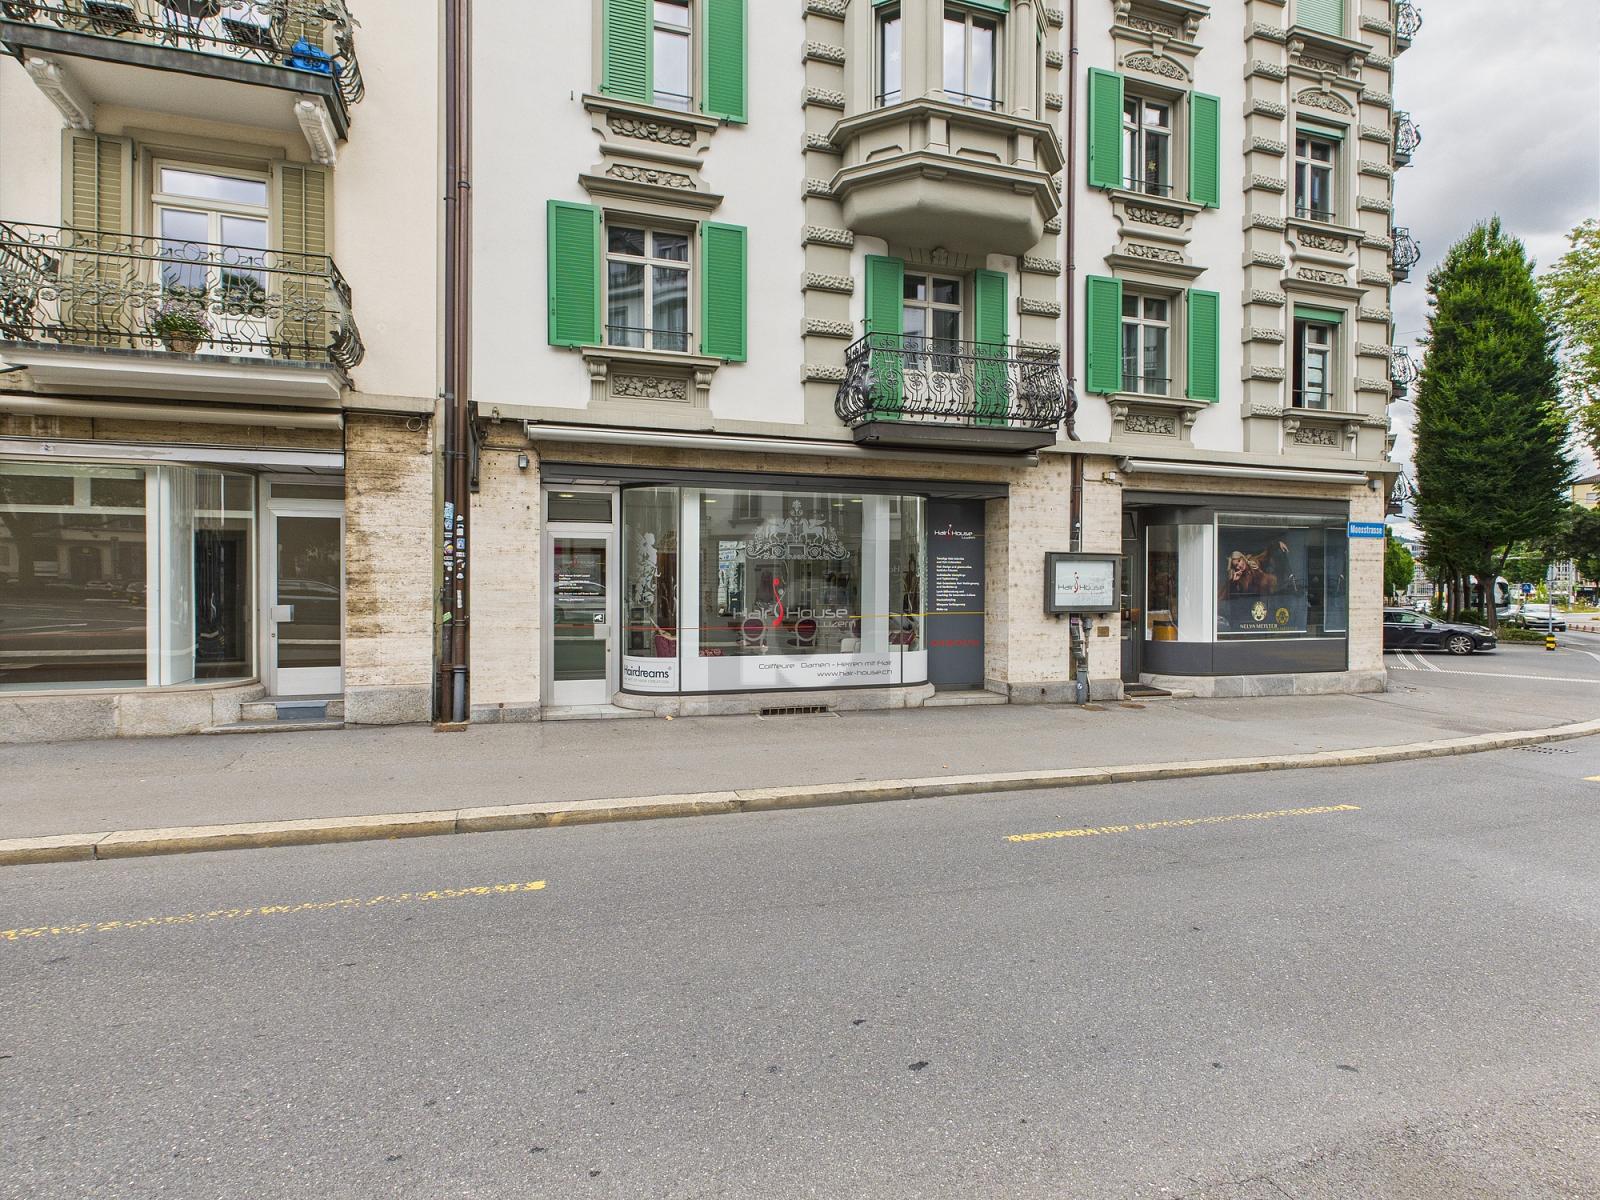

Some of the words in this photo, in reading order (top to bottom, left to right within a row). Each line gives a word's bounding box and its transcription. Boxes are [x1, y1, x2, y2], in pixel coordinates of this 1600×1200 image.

[1350, 524, 1383, 535] Moosstrasse
[733, 607, 771, 619] Hair
[786, 607, 848, 619] House
